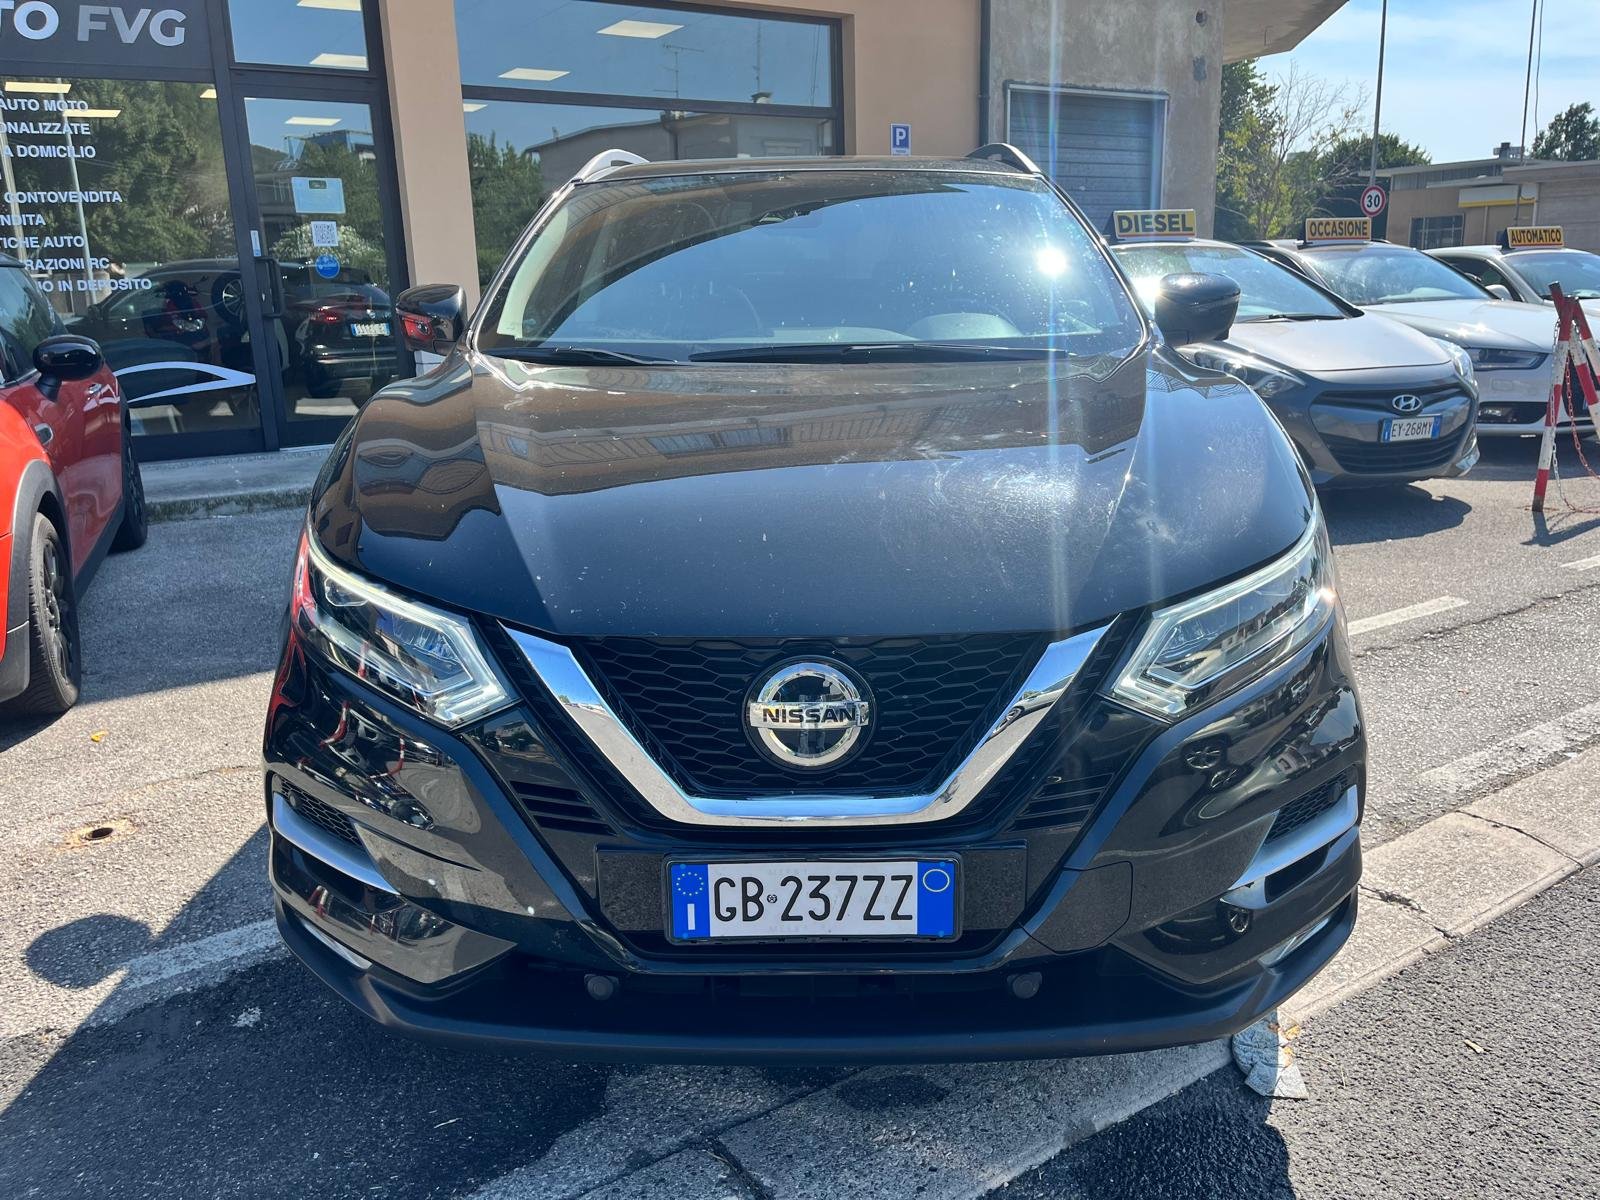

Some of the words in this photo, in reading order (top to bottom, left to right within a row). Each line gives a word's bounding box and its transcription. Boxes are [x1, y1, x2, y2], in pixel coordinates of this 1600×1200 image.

[77, 5, 187, 47] FVG
[43, 100, 88, 112] MOTO
[895, 128, 906, 146] P
[4, 145, 14, 157] A
[16, 145, 96, 158] DOMICILIO
[4, 190, 122, 203] CONTOVENDITA
[1366, 194, 1380, 208] 30
[1117, 214, 1193, 233] DIESEL
[1309, 221, 1367, 236] OCCASIONE
[0, 236, 40, 248] ICHE
[44, 236, 85, 248] AUTO
[1511, 228, 1562, 243] AUTOMATICO
[90, 257, 110, 269] RC
[58, 281, 73, 292] IN
[77, 279, 152, 292] DEPOSITO
[762, 707, 856, 723] NISSAN
